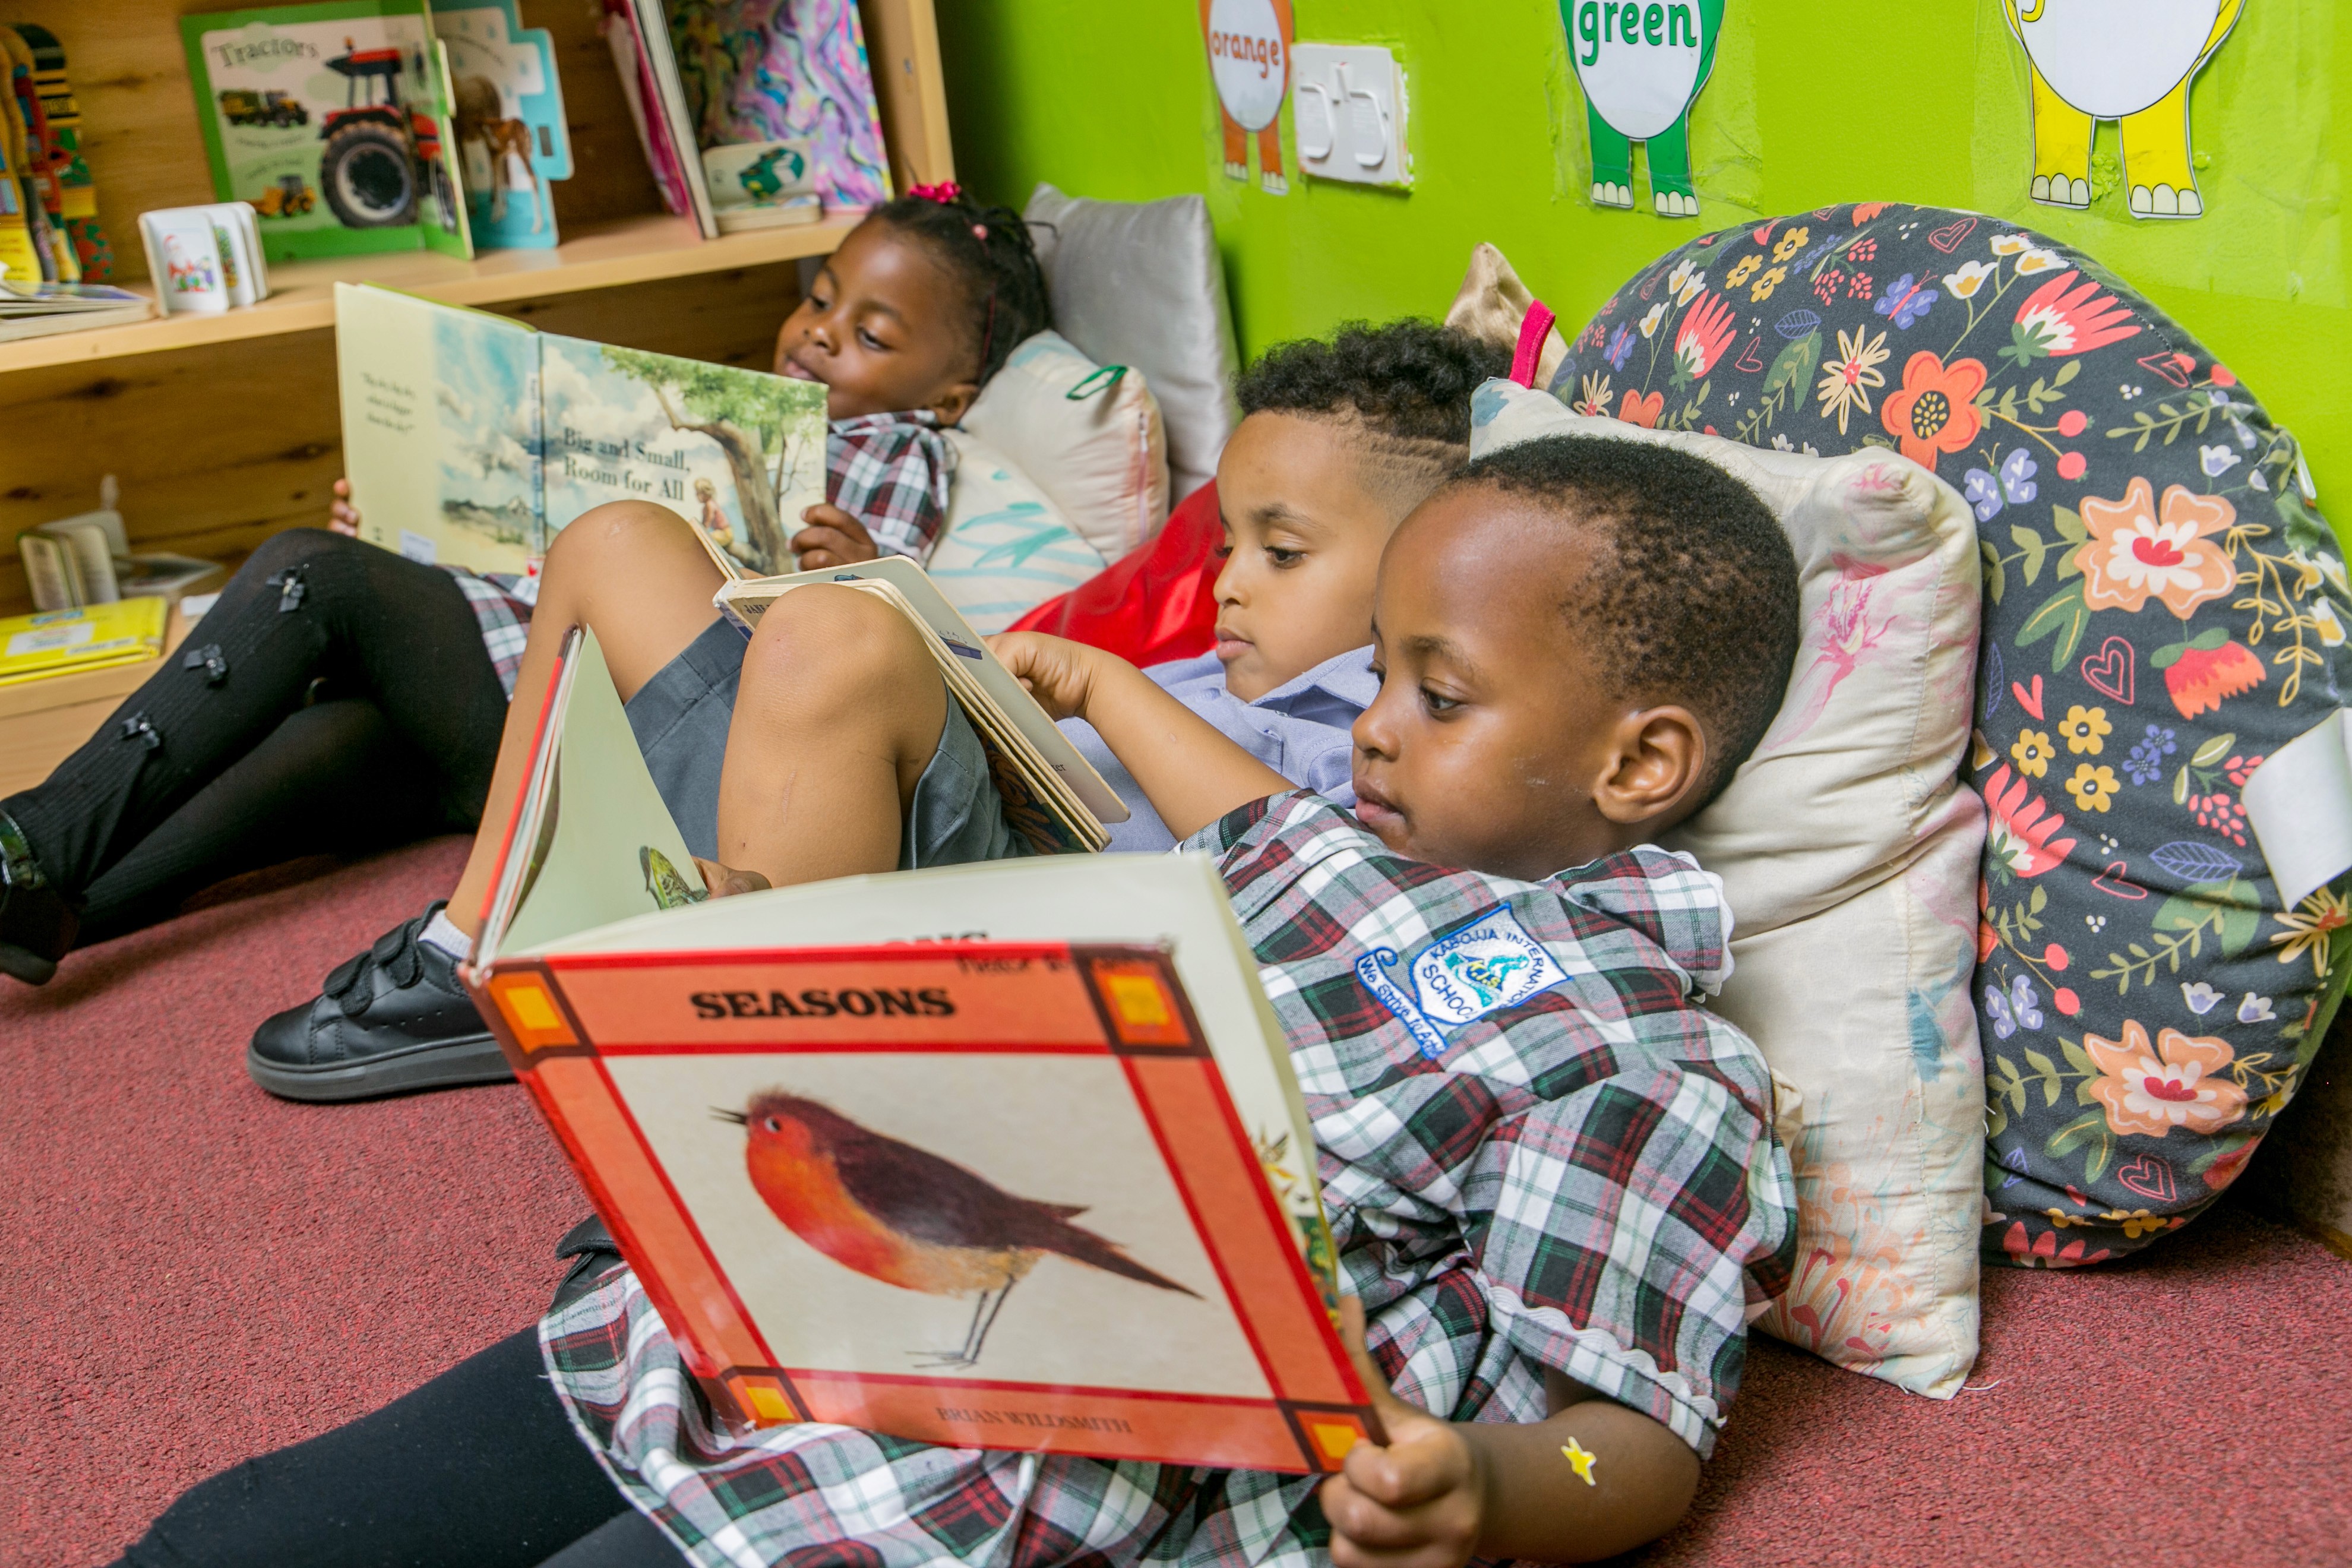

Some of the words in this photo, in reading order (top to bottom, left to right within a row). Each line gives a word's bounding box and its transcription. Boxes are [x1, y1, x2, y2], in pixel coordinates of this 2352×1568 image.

[210, 38, 320, 68] Tractors
[1212, 30, 1280, 80] orange
[1579, 1, 1697, 67] green
[565, 427, 593, 453] Big
[598, 438, 629, 458] and
[635, 441, 691, 473] Small,
[565, 456, 618, 486] Room
[624, 469, 652, 494] for
[659, 479, 684, 501] All
[1360, 957, 1377, 983] We
[1498, 932, 1545, 1009] INTERNATIO
[690, 987, 956, 1020] SEASONS
[935, 1406, 1004, 1425] BRIAN
[1004, 1411, 1133, 1433] WILDSMITH
